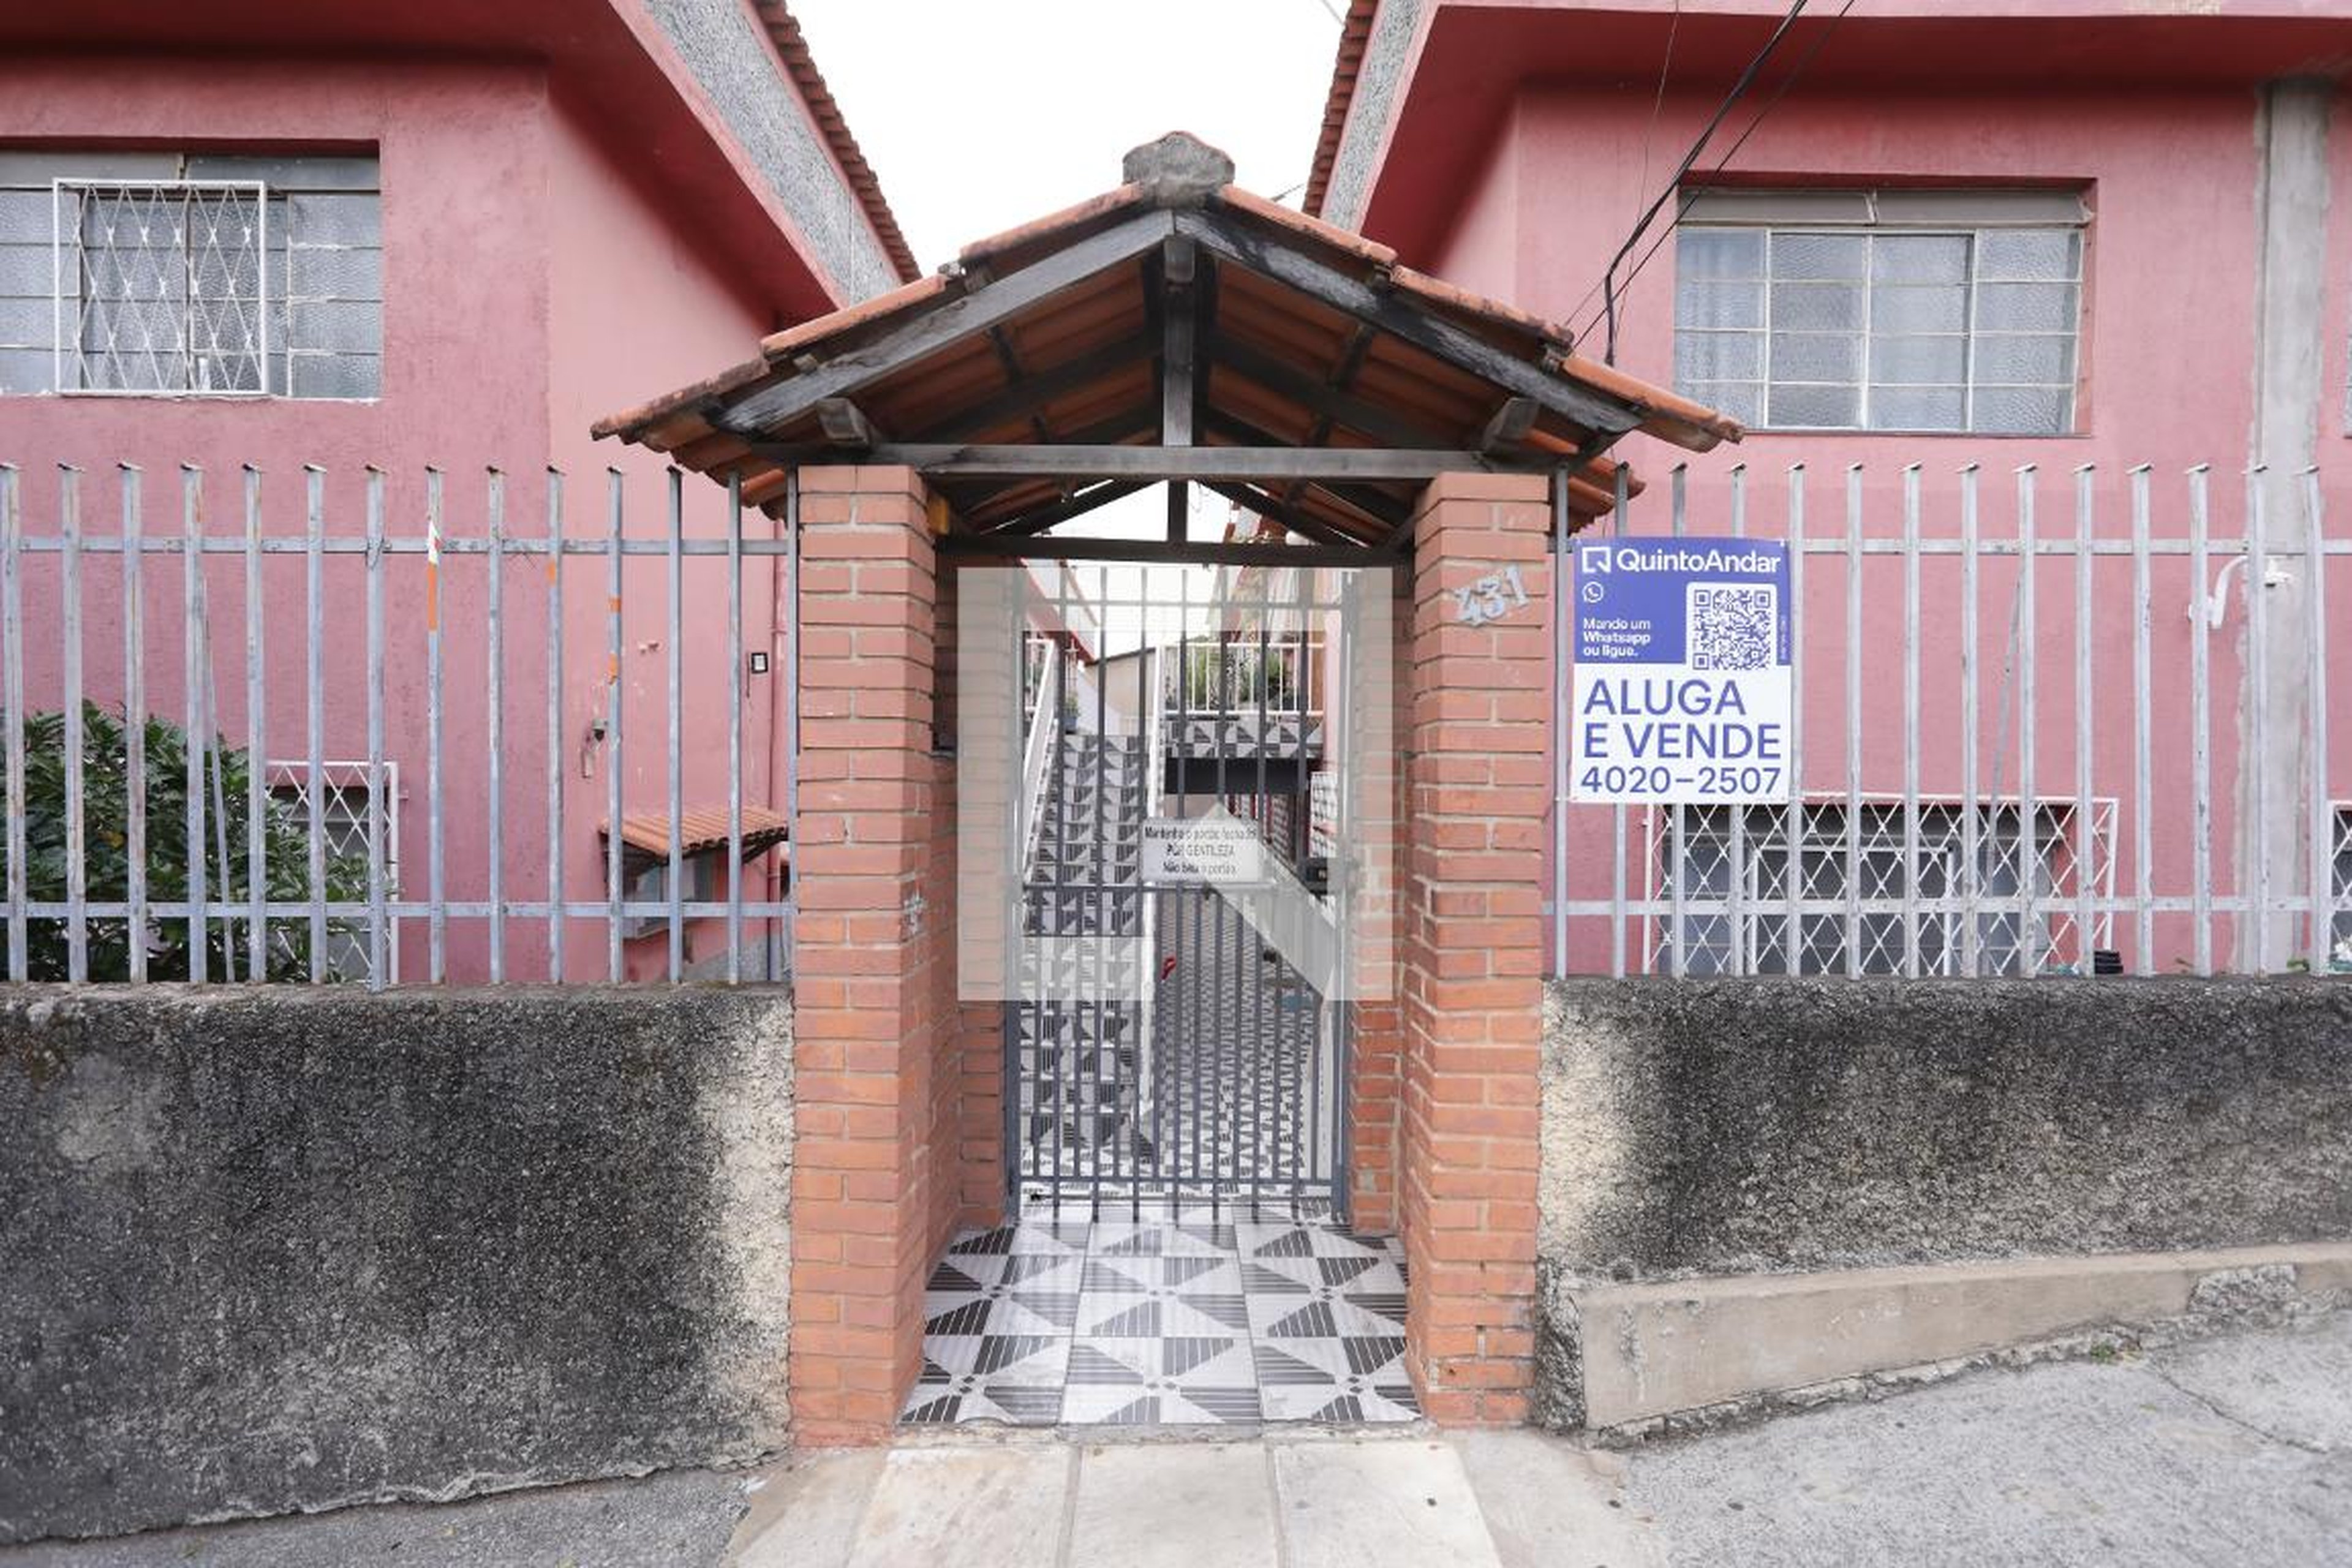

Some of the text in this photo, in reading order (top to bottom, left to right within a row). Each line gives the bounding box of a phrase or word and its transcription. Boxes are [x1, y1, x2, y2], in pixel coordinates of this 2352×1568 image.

[1616, 548, 1781, 573] QuintoAndar
[1630, 620, 1651, 630] um
[1583, 646, 1600, 657] ou
[1583, 678, 1746, 715] ALUGA
[1584, 723, 1781, 759] E VENDE
[1581, 765, 1781, 794] 4020-2507
